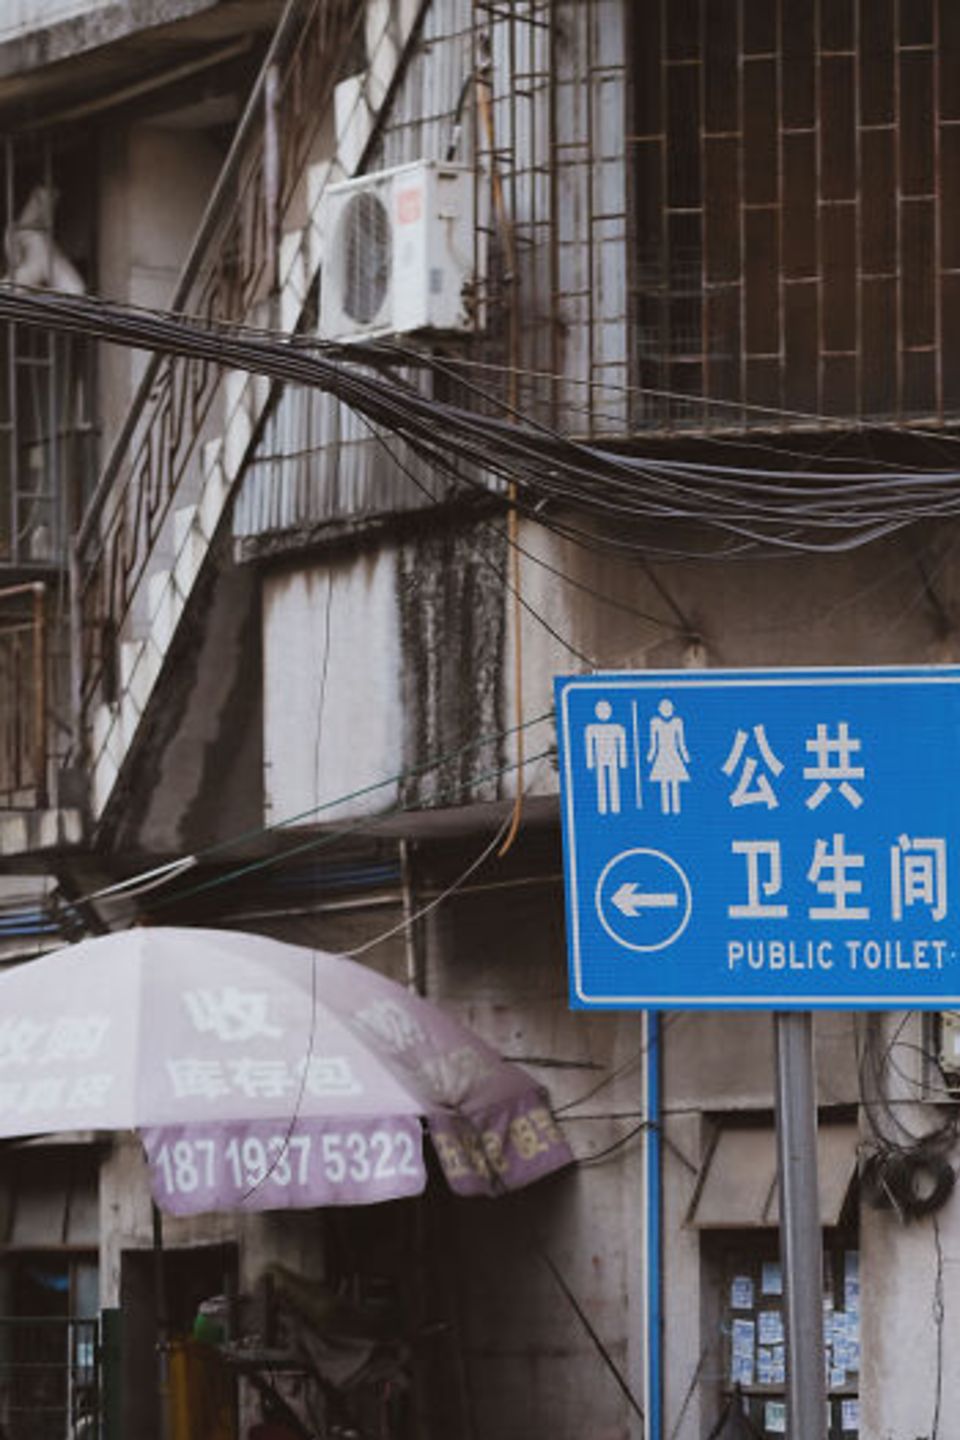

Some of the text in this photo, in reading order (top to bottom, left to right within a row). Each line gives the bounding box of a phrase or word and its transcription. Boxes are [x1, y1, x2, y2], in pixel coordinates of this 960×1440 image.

[721, 722, 865, 811] 公共
[727, 833, 948, 922] 卫生间
[727, 940, 947, 970] PUBLIC TOILET
[156, 1140, 217, 1196] 187
[226, 1136, 311, 1189] 1937
[325, 1131, 418, 1180] 5322
